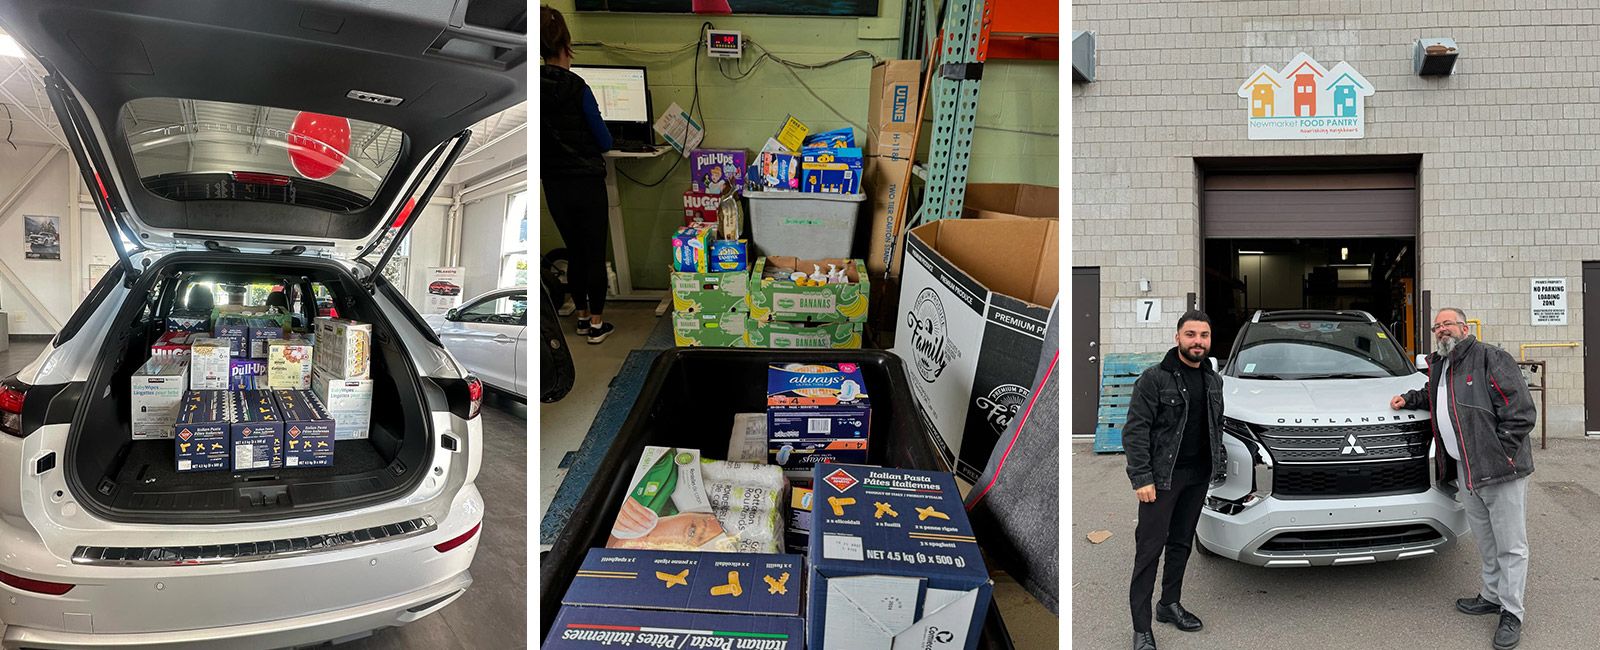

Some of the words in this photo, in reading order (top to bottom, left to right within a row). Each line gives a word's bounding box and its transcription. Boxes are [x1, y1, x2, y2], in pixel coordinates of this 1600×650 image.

[894, 87, 907, 121] ULINE
[1250, 120, 1298, 128] Newmarket
[1300, 118, 1324, 127] FOOD
[1326, 118, 1358, 126] PANTRY
[697, 153, 734, 170] Pull-Ups
[683, 195, 721, 208] HUGG
[884, 216, 894, 243] CARTON
[800, 298, 832, 309] BANANAS
[1144, 301, 1154, 320] 7
[994, 312, 1035, 332] PREMIUM
[796, 338, 826, 348] BANANAS
[907, 310, 948, 378] Family
[232, 363, 266, 376] Pull-Up
[789, 374, 840, 386] always
[992, 386, 1016, 398] PREMIUM
[1277, 414, 1416, 424] OUTLANDER
[869, 471, 901, 480] Italian
[903, 474, 931, 483] Pasta
[863, 478, 890, 487] Pâtes
[892, 480, 941, 490] italiennes
[866, 550, 885, 560] NET
[887, 552, 901, 561] 4.5
[903, 552, 914, 563] kg
[917, 553, 927, 564] (9
[935, 555, 953, 565] 500
[955, 556, 966, 568] g)
[562, 629, 634, 646] italiennes
[636, 632, 679, 648] Pâtes
[678, 634, 691, 650] /
[690, 636, 732, 650] Pasta
[737, 639, 788, 650] Italian
